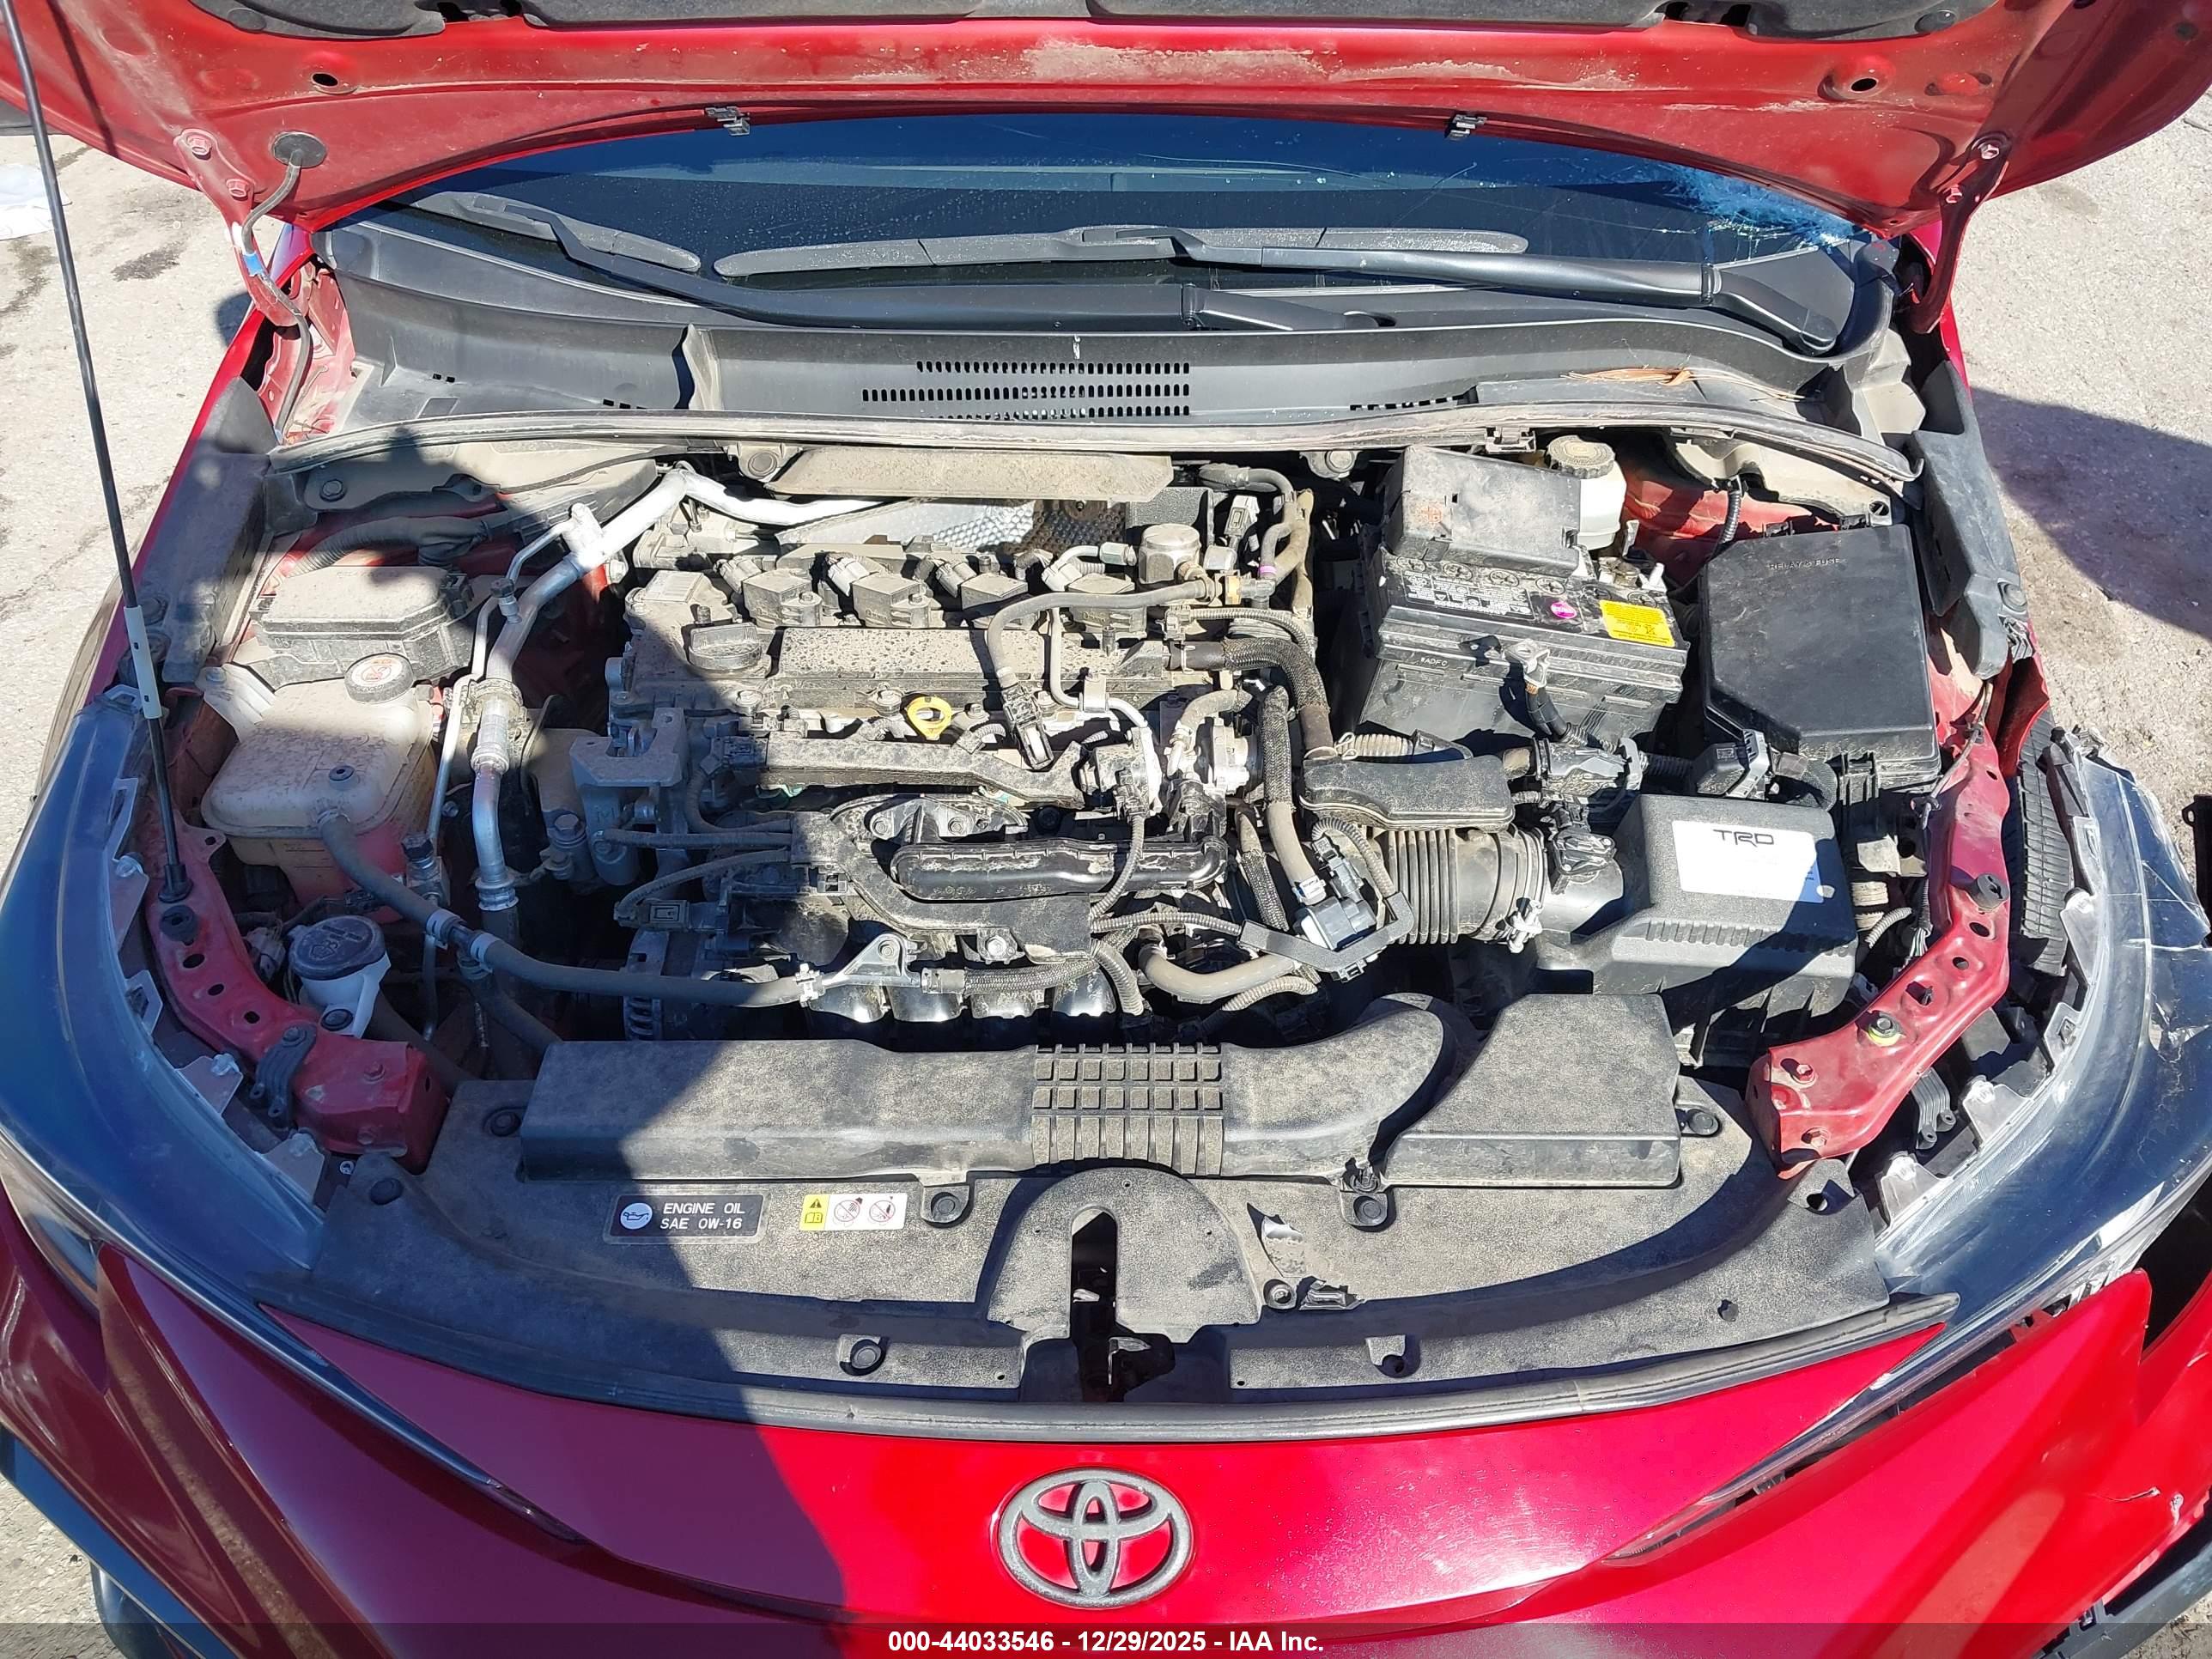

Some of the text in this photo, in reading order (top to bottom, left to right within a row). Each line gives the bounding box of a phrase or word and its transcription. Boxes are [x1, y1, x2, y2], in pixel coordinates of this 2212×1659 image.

[1769, 561, 1802, 570] RELAY
[1814, 557, 1840, 567] FUSE
[1713, 829, 1775, 848] TRD
[663, 1202, 746, 1215] ENGINE OIL
[659, 1217, 744, 1230] SAE 0W-16
